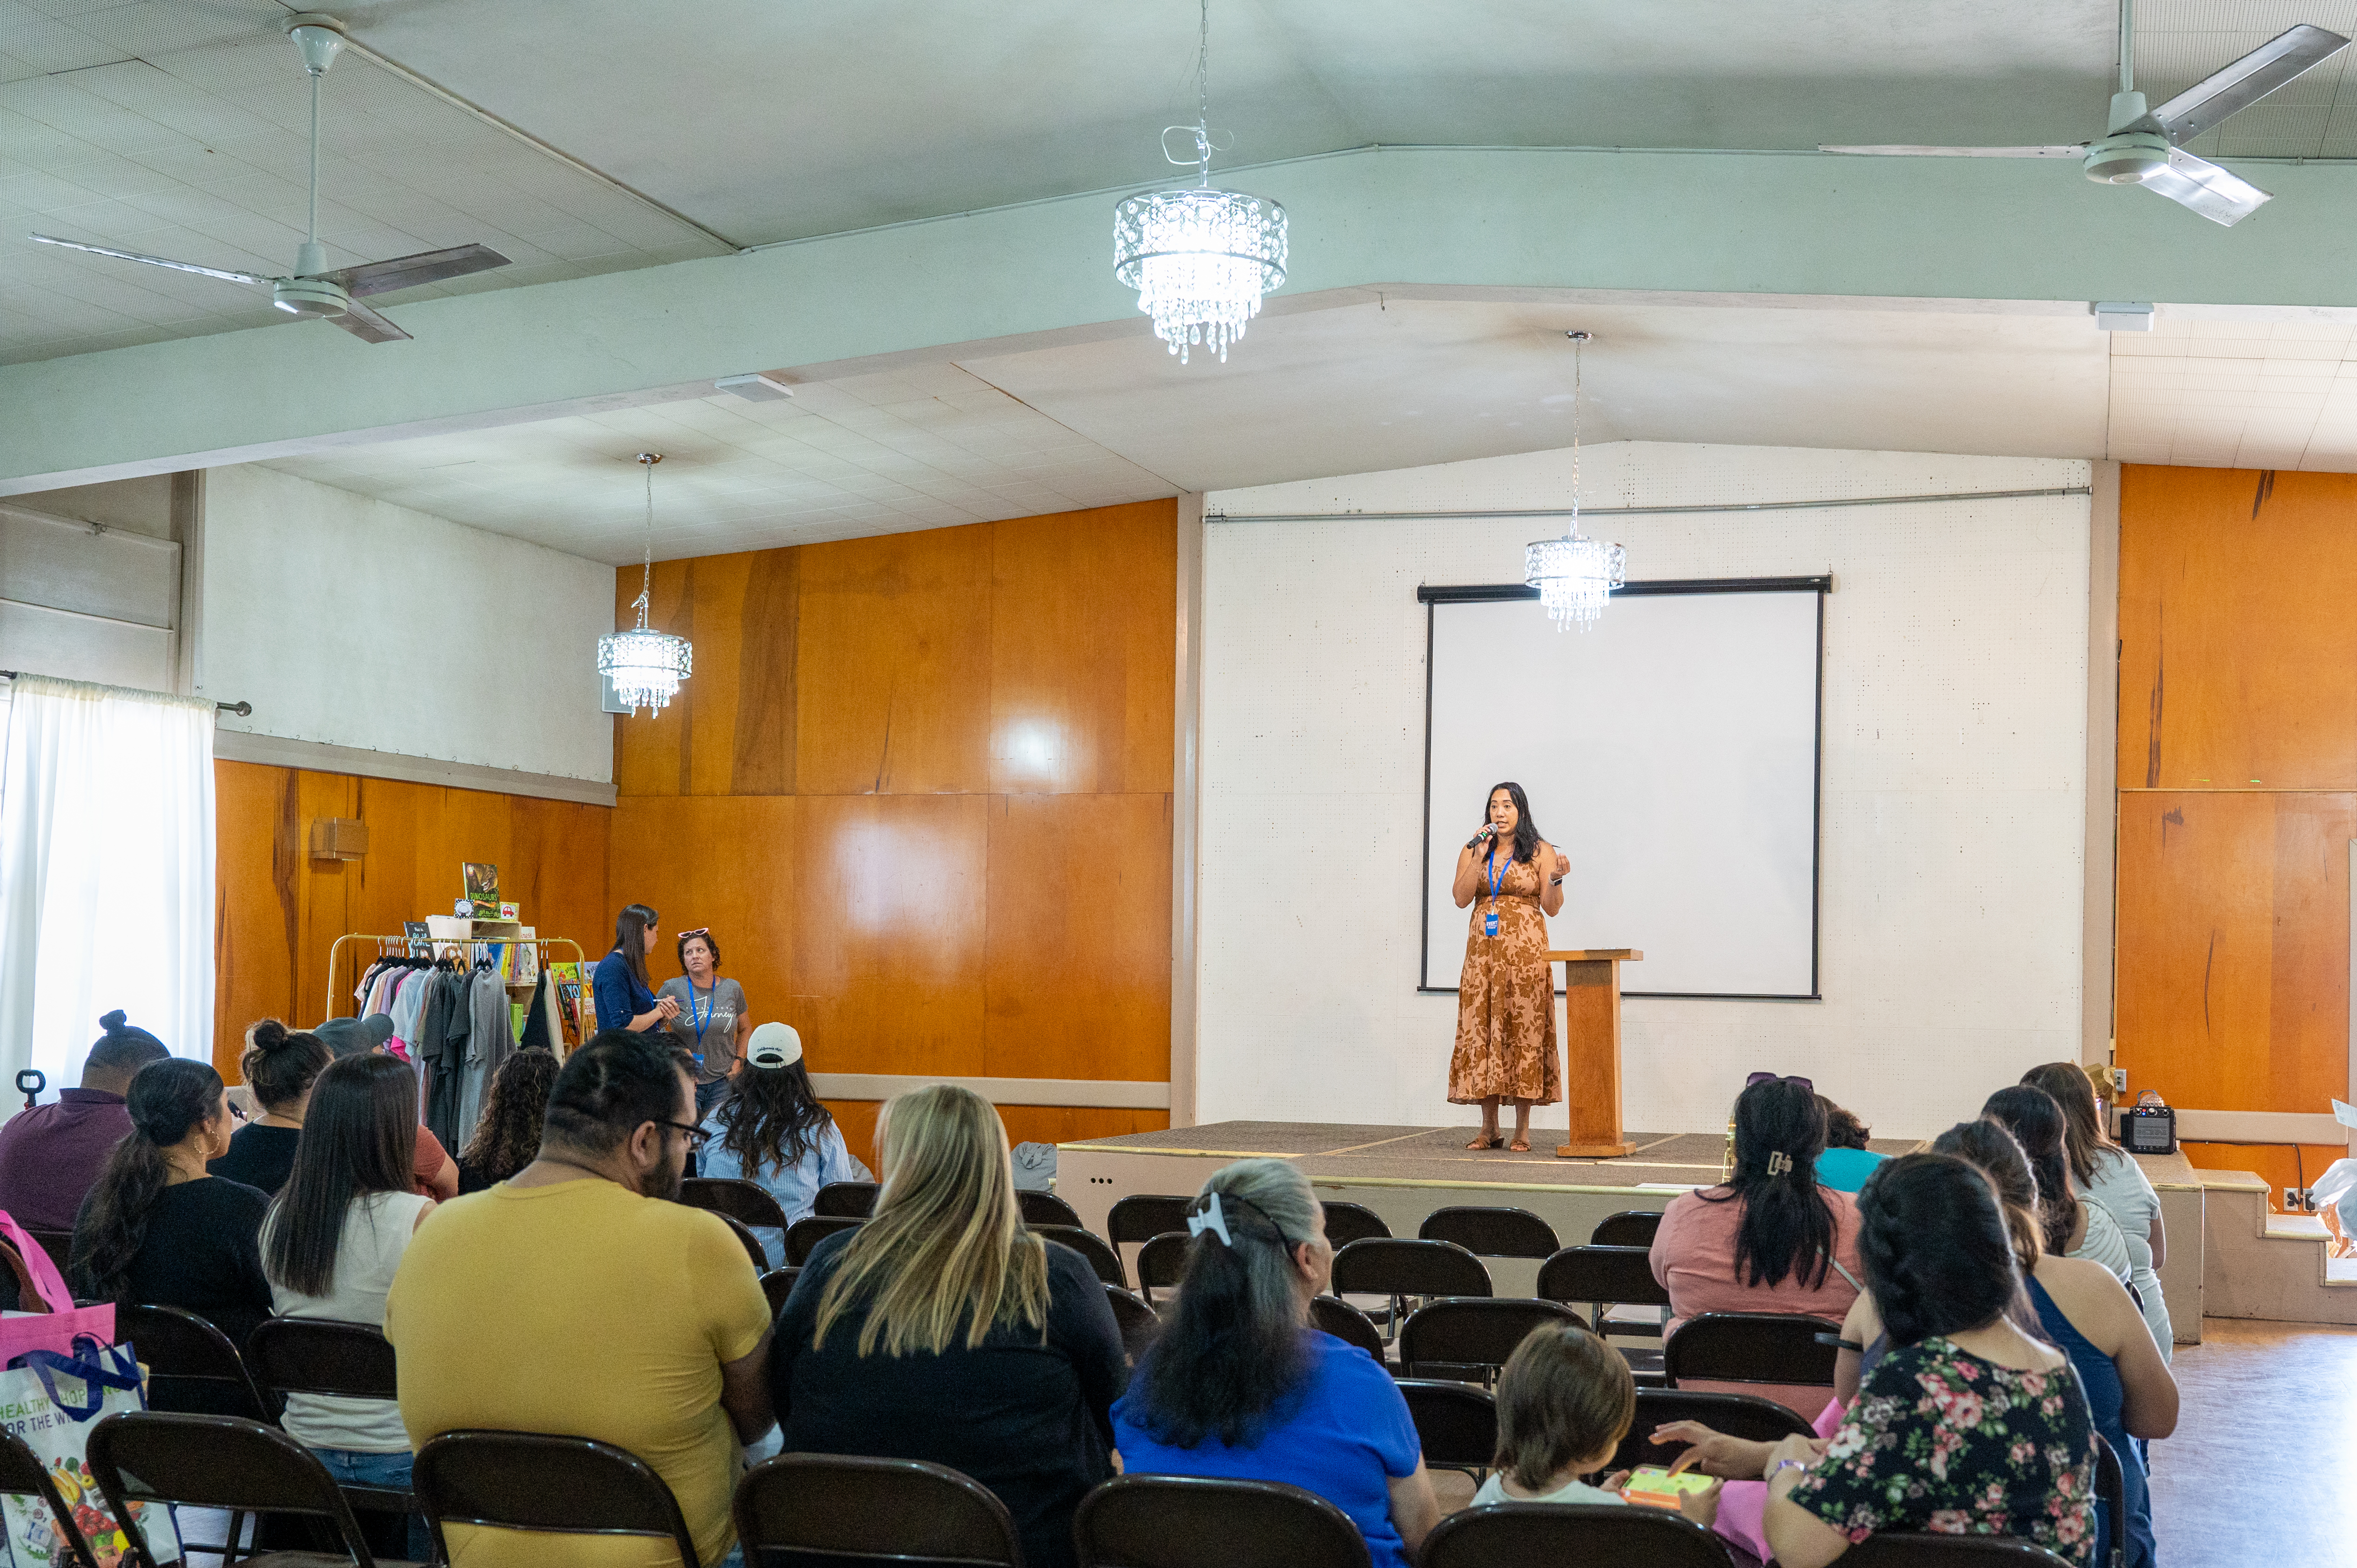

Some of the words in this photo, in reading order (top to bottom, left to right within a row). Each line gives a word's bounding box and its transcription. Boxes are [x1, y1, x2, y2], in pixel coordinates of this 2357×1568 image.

[470, 892, 497, 901] DINOSAURS
[566, 985, 581, 998] YO
[685, 996, 734, 1033] Journey
[6, 1421, 27, 1434] OR
[30, 1414, 53, 1431] THE
